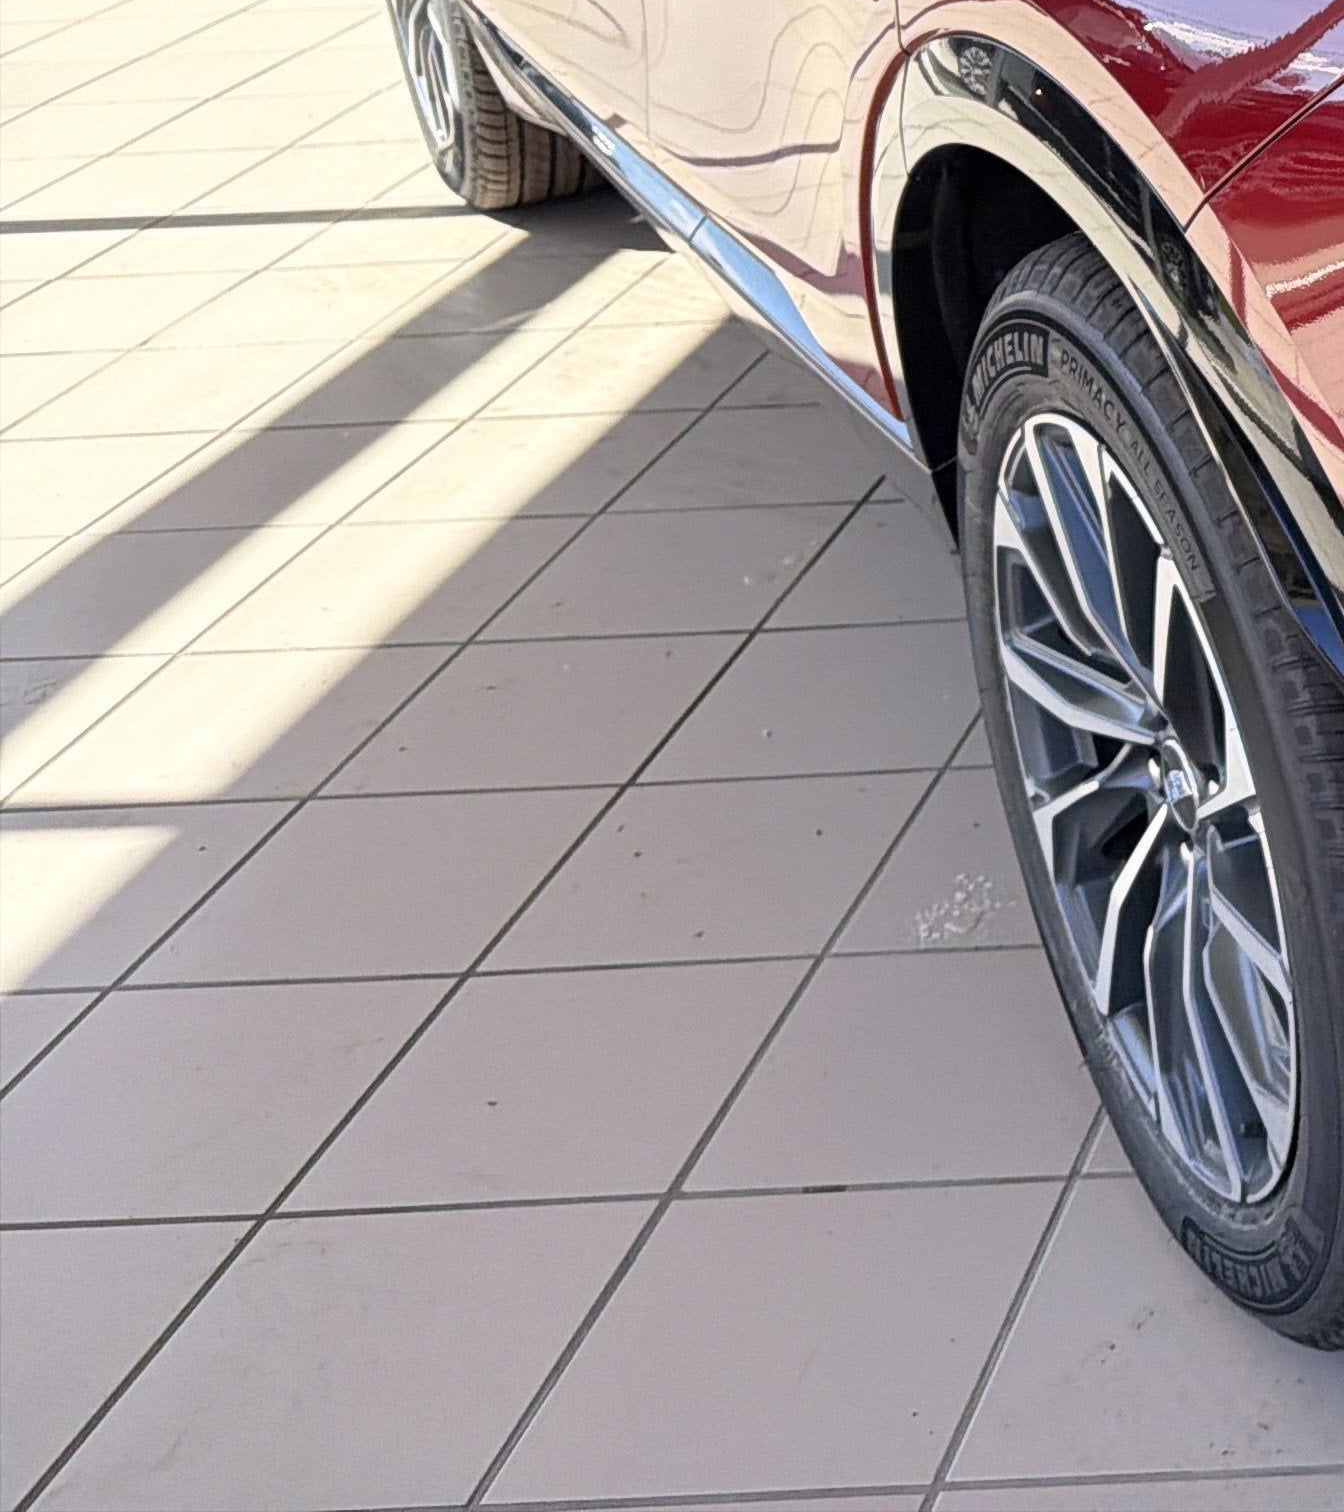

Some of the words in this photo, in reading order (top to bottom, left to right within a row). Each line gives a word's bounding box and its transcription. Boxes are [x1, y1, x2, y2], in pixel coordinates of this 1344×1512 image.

[974, 331, 1044, 399] MICHELIN
[1059, 350, 1126, 432] PRIMACY
[1130, 441, 1152, 475] ALL
[1155, 478, 1199, 571] SEASON
